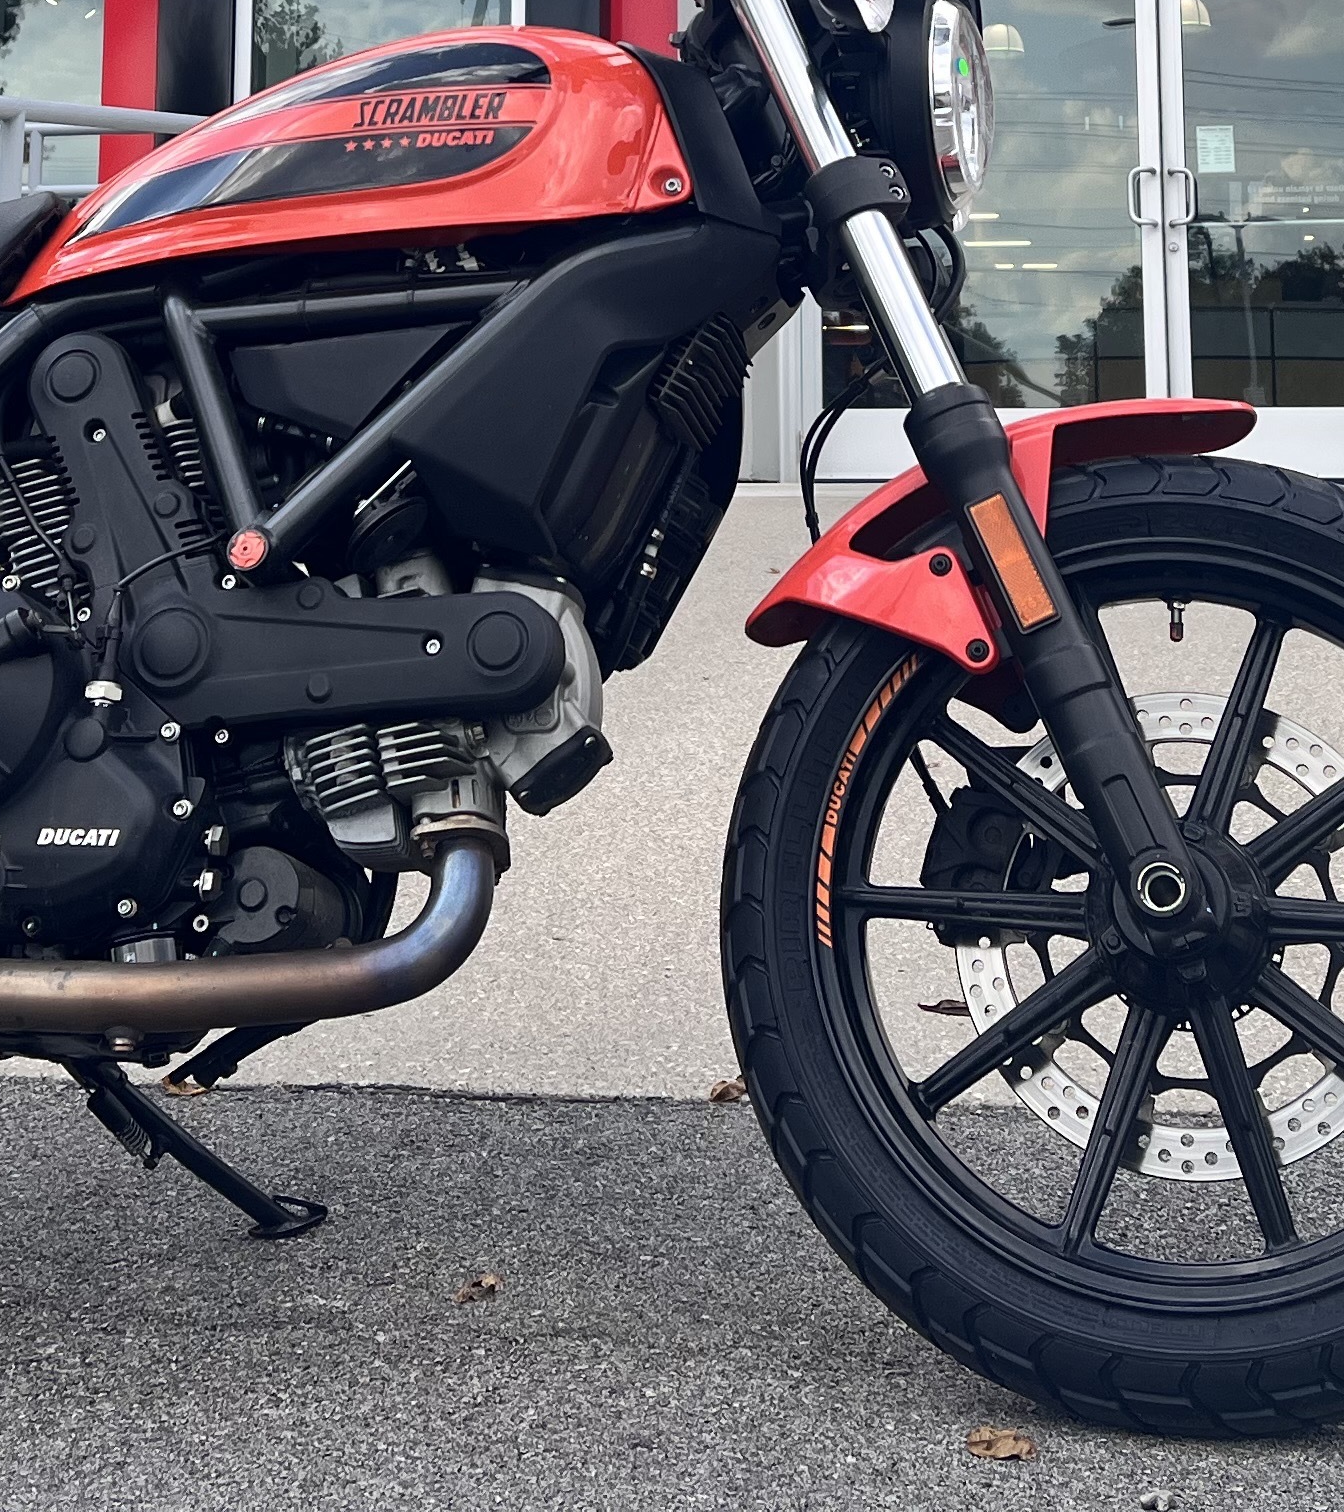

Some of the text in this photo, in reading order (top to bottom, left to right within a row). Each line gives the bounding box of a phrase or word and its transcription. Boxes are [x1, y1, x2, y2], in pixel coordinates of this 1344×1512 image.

[353, 91, 508, 128] SCRAMBLER
[416, 129, 495, 148] DUCATI
[826, 752, 857, 825] DUCATI
[36, 828, 120, 846] DUCATI
